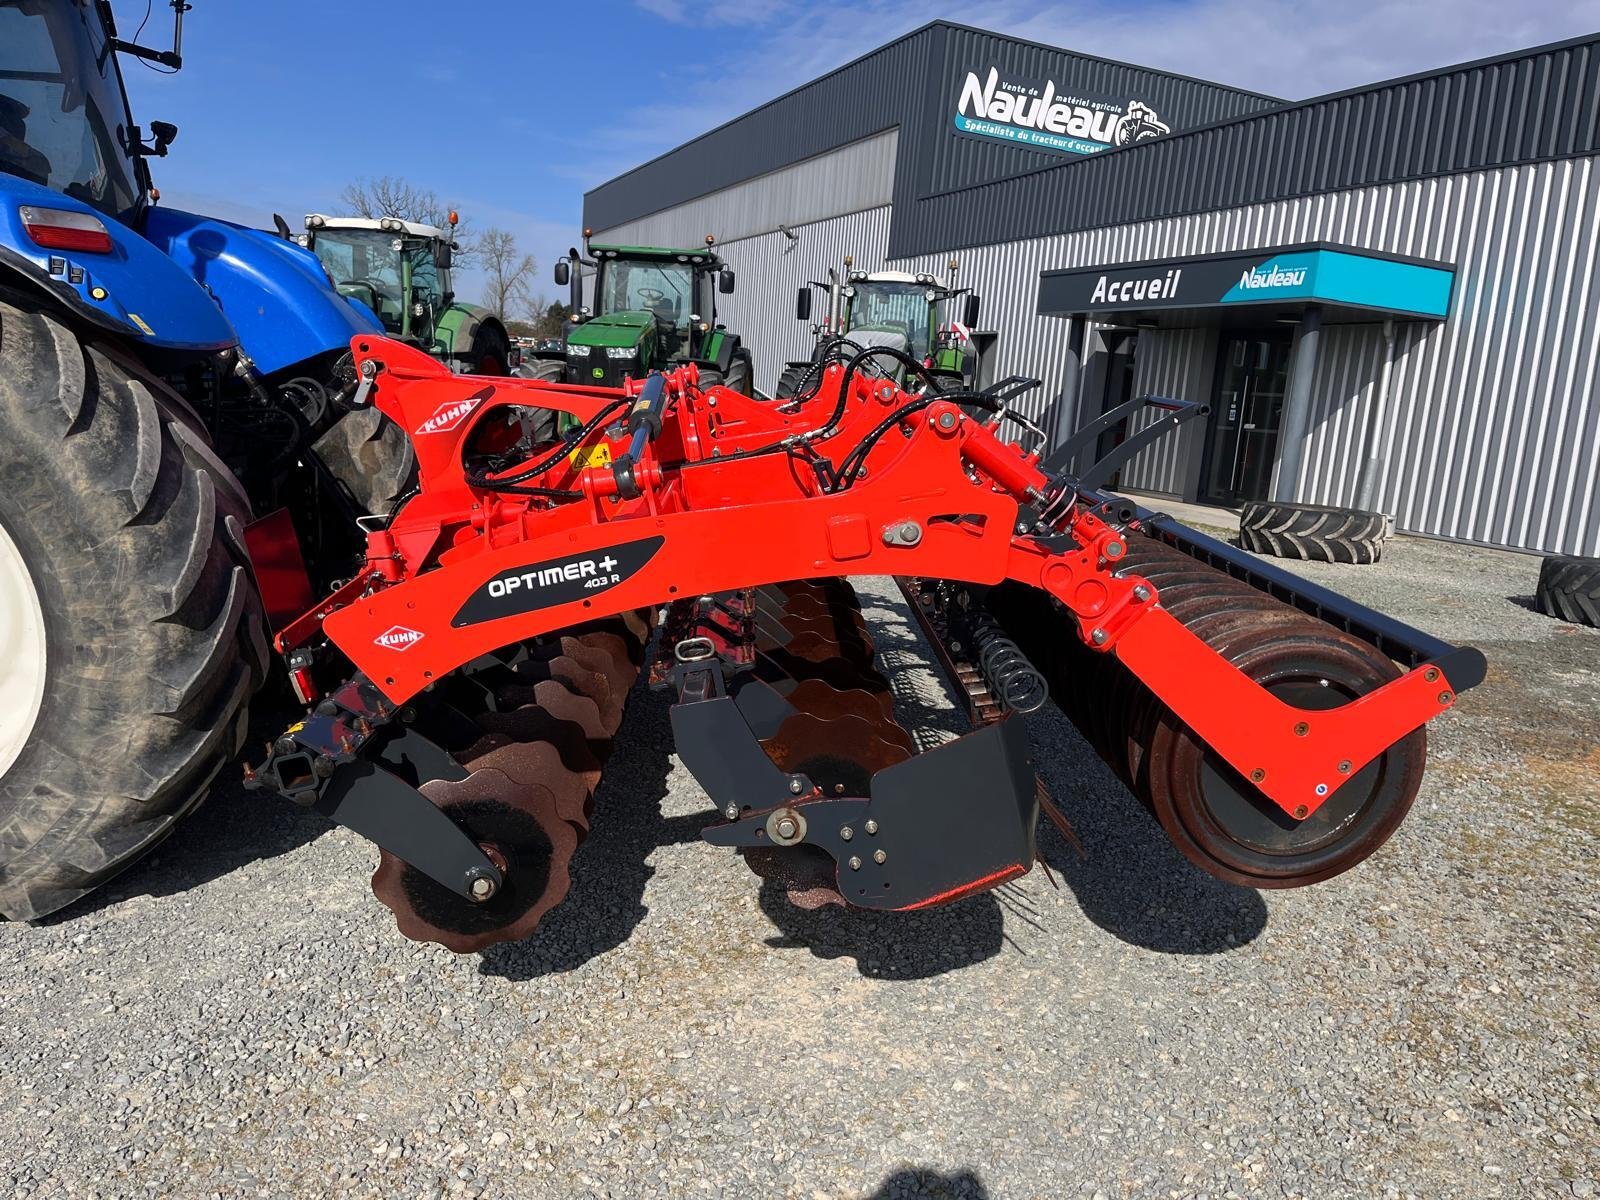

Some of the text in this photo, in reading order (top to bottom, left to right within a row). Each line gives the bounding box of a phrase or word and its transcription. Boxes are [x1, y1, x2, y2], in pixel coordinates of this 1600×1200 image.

[958, 66, 1119, 142] Nauleau
[1002, 81, 1122, 114] Vente de matériel agricole
[964, 119, 1015, 137] Spécialiste
[1017, 131, 1028, 140] du
[1090, 269, 1182, 303] Accueil
[1239, 264, 1306, 290] Nauleau
[424, 400, 472, 433] KUHN
[584, 573, 621, 589] 403 R
[380, 631, 418, 645] KUHN
